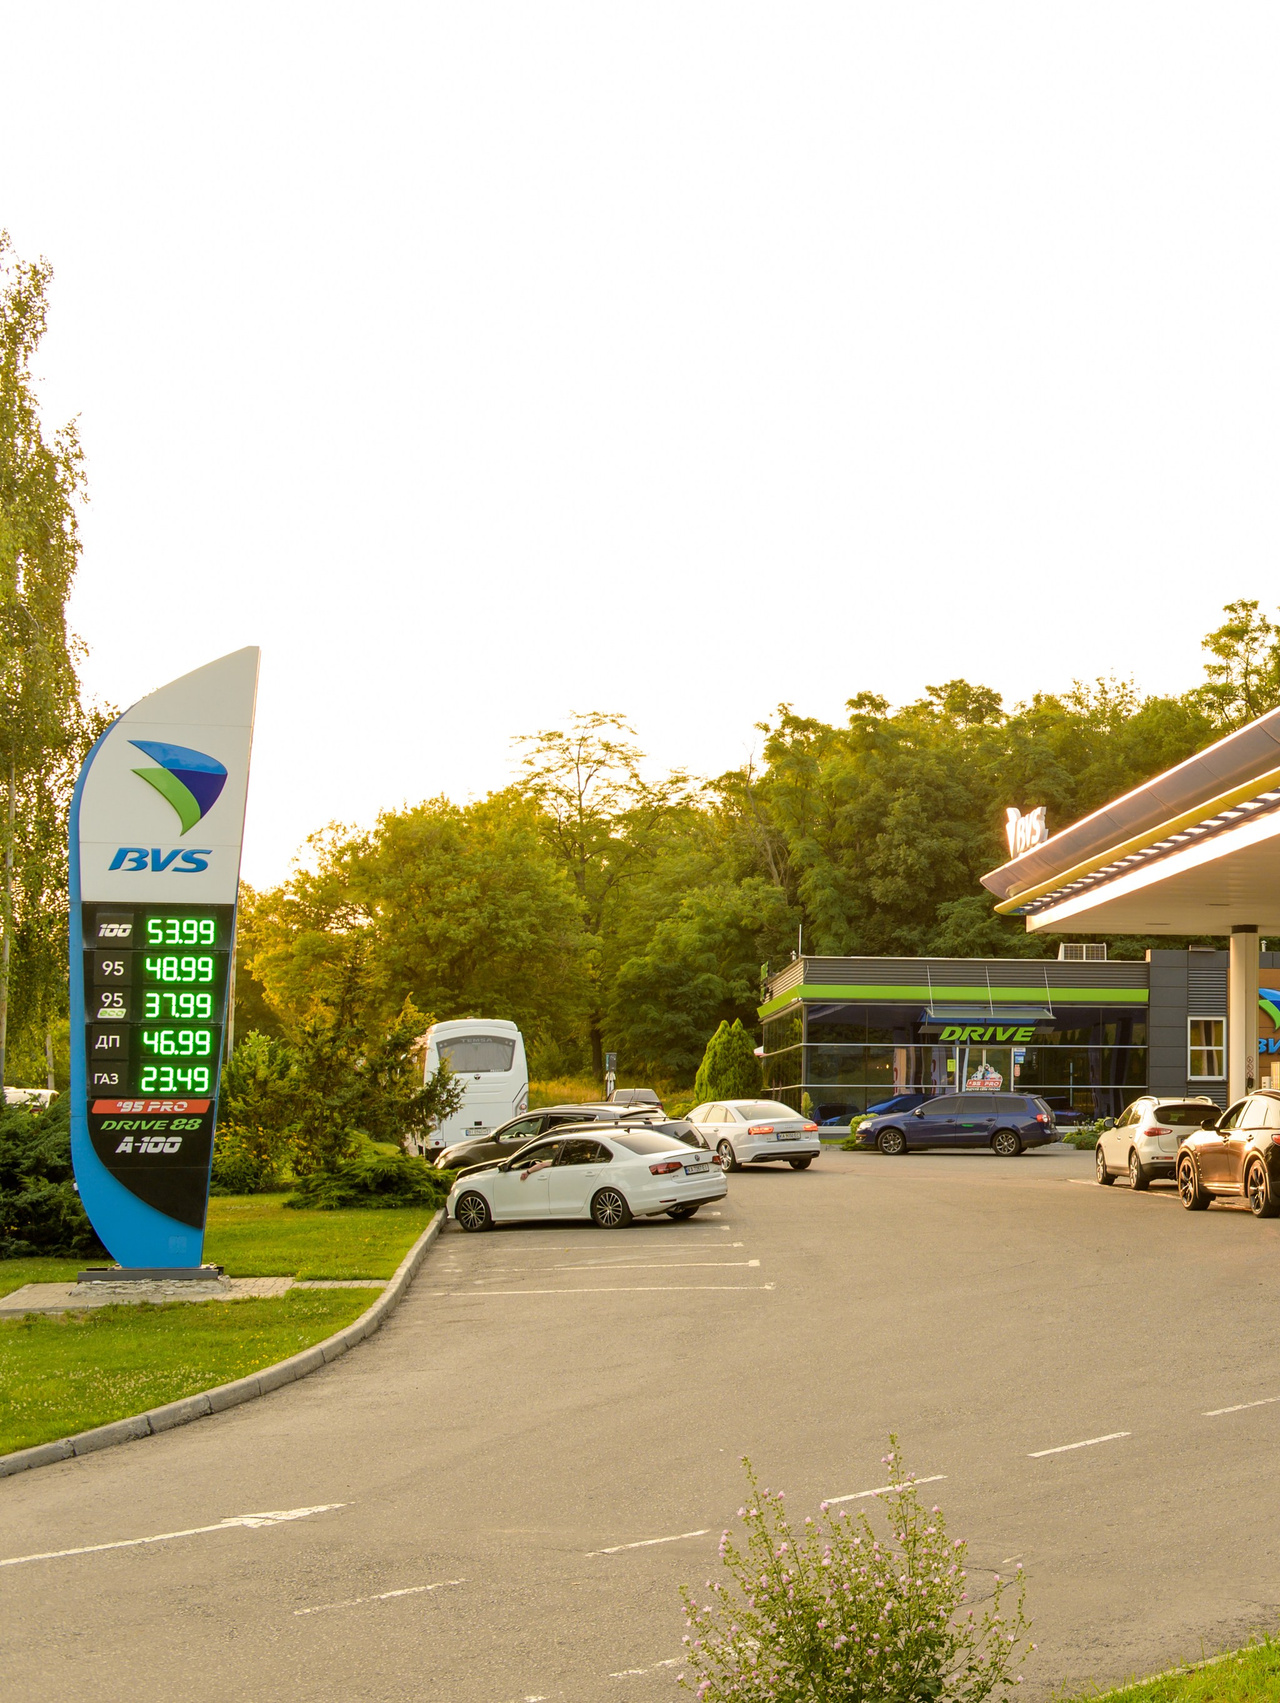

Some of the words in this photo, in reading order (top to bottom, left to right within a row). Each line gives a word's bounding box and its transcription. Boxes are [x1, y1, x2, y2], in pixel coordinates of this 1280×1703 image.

[108, 847, 213, 873] BVS
[98, 924, 132, 937] 100
[147, 919, 215, 944] 53.99
[102, 961, 124, 976] 95
[145, 957, 213, 982] 48.99
[99, 1009, 125, 1017] eco
[101, 992, 124, 1007] 95
[145, 993, 212, 1018] 37.99
[95, 1035, 120, 1050] ДП
[143, 1030, 210, 1055] 46.99
[939, 1026, 1036, 1041] DRIVE
[94, 1073, 119, 1085] ГАЗ
[141, 1067, 209, 1091] 23.49
[147, 1101, 188, 1112] PRO
[100, 1120, 169, 1131] DRIVE
[169, 1118, 203, 1131] 88
[115, 1136, 183, 1154] A-100
